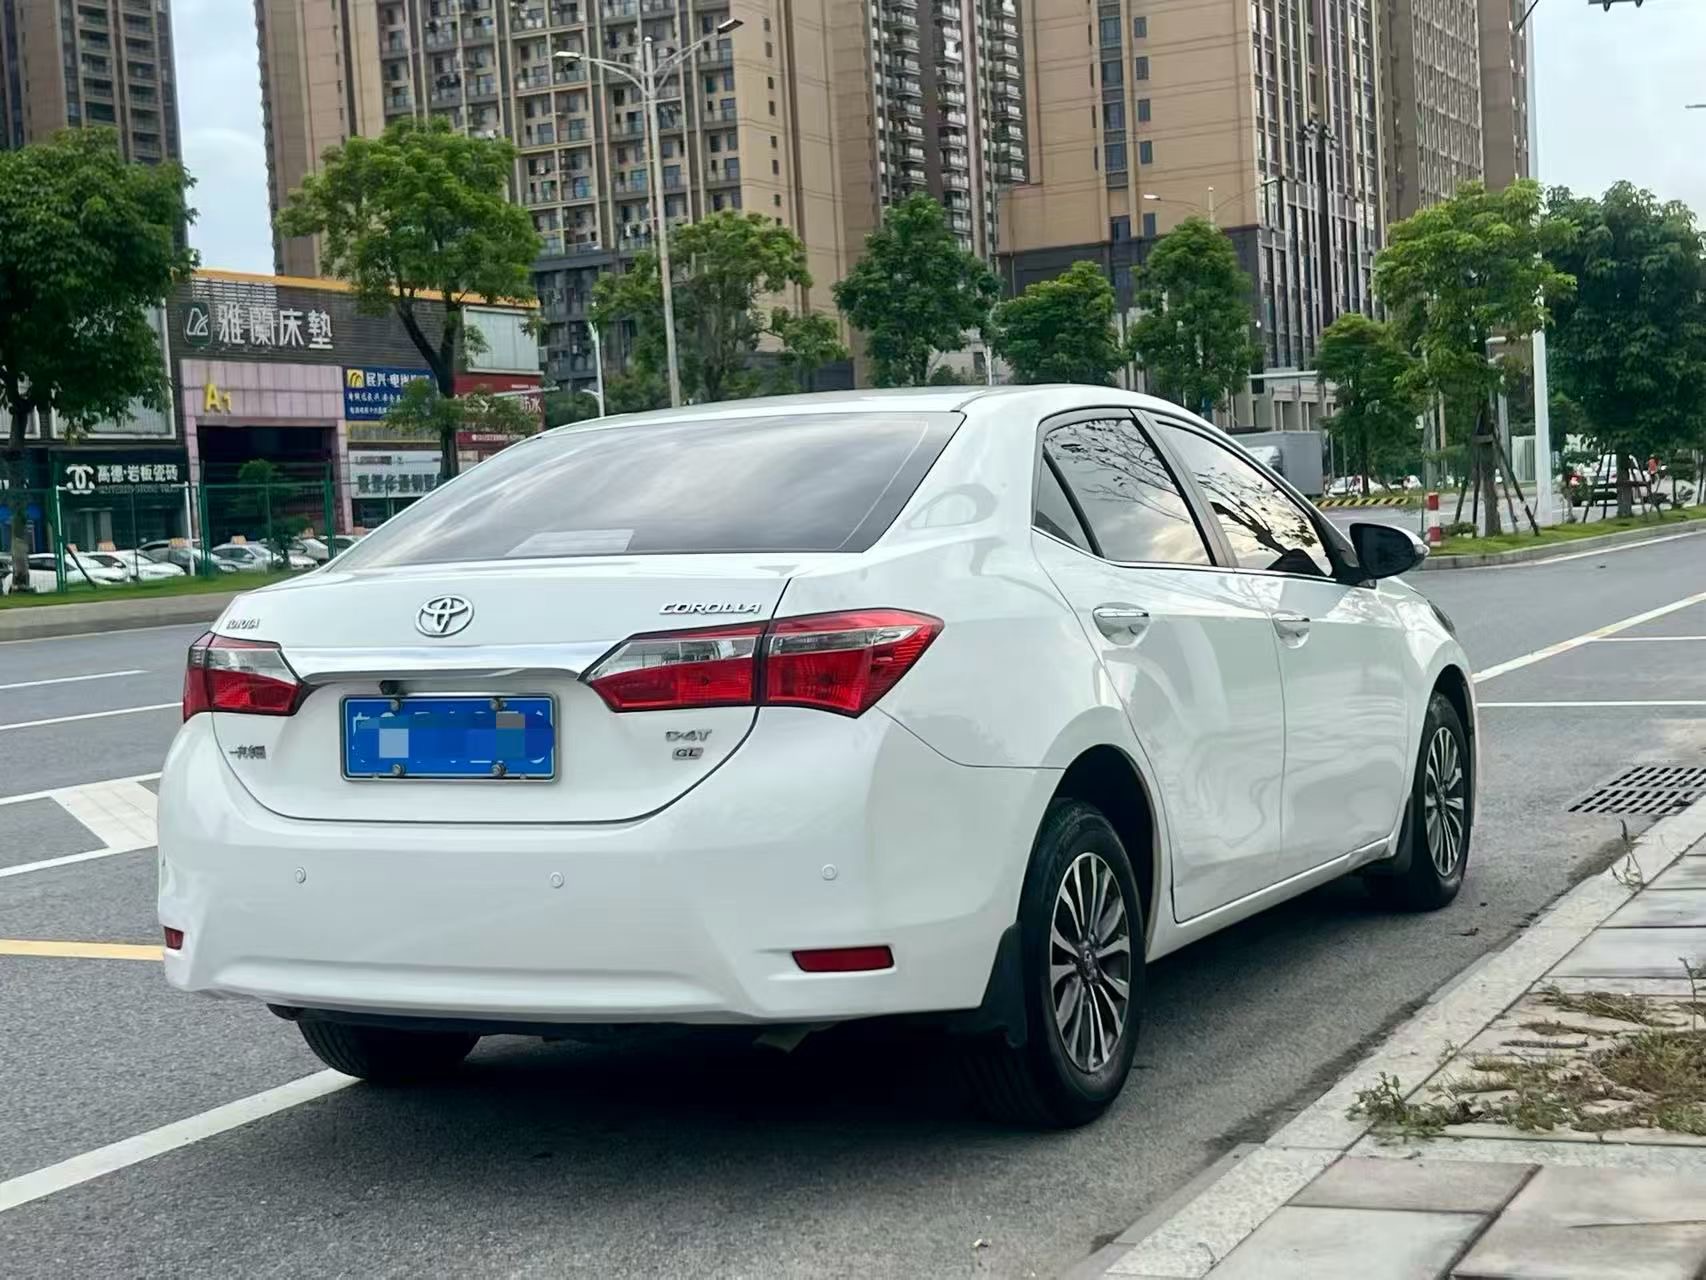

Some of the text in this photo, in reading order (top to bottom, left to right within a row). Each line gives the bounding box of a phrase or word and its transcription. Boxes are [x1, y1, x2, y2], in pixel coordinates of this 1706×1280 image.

[218, 302, 334, 349] 雅蘭床墊
[204, 384, 232, 413] A1
[659, 602, 761, 615] COROLLA
